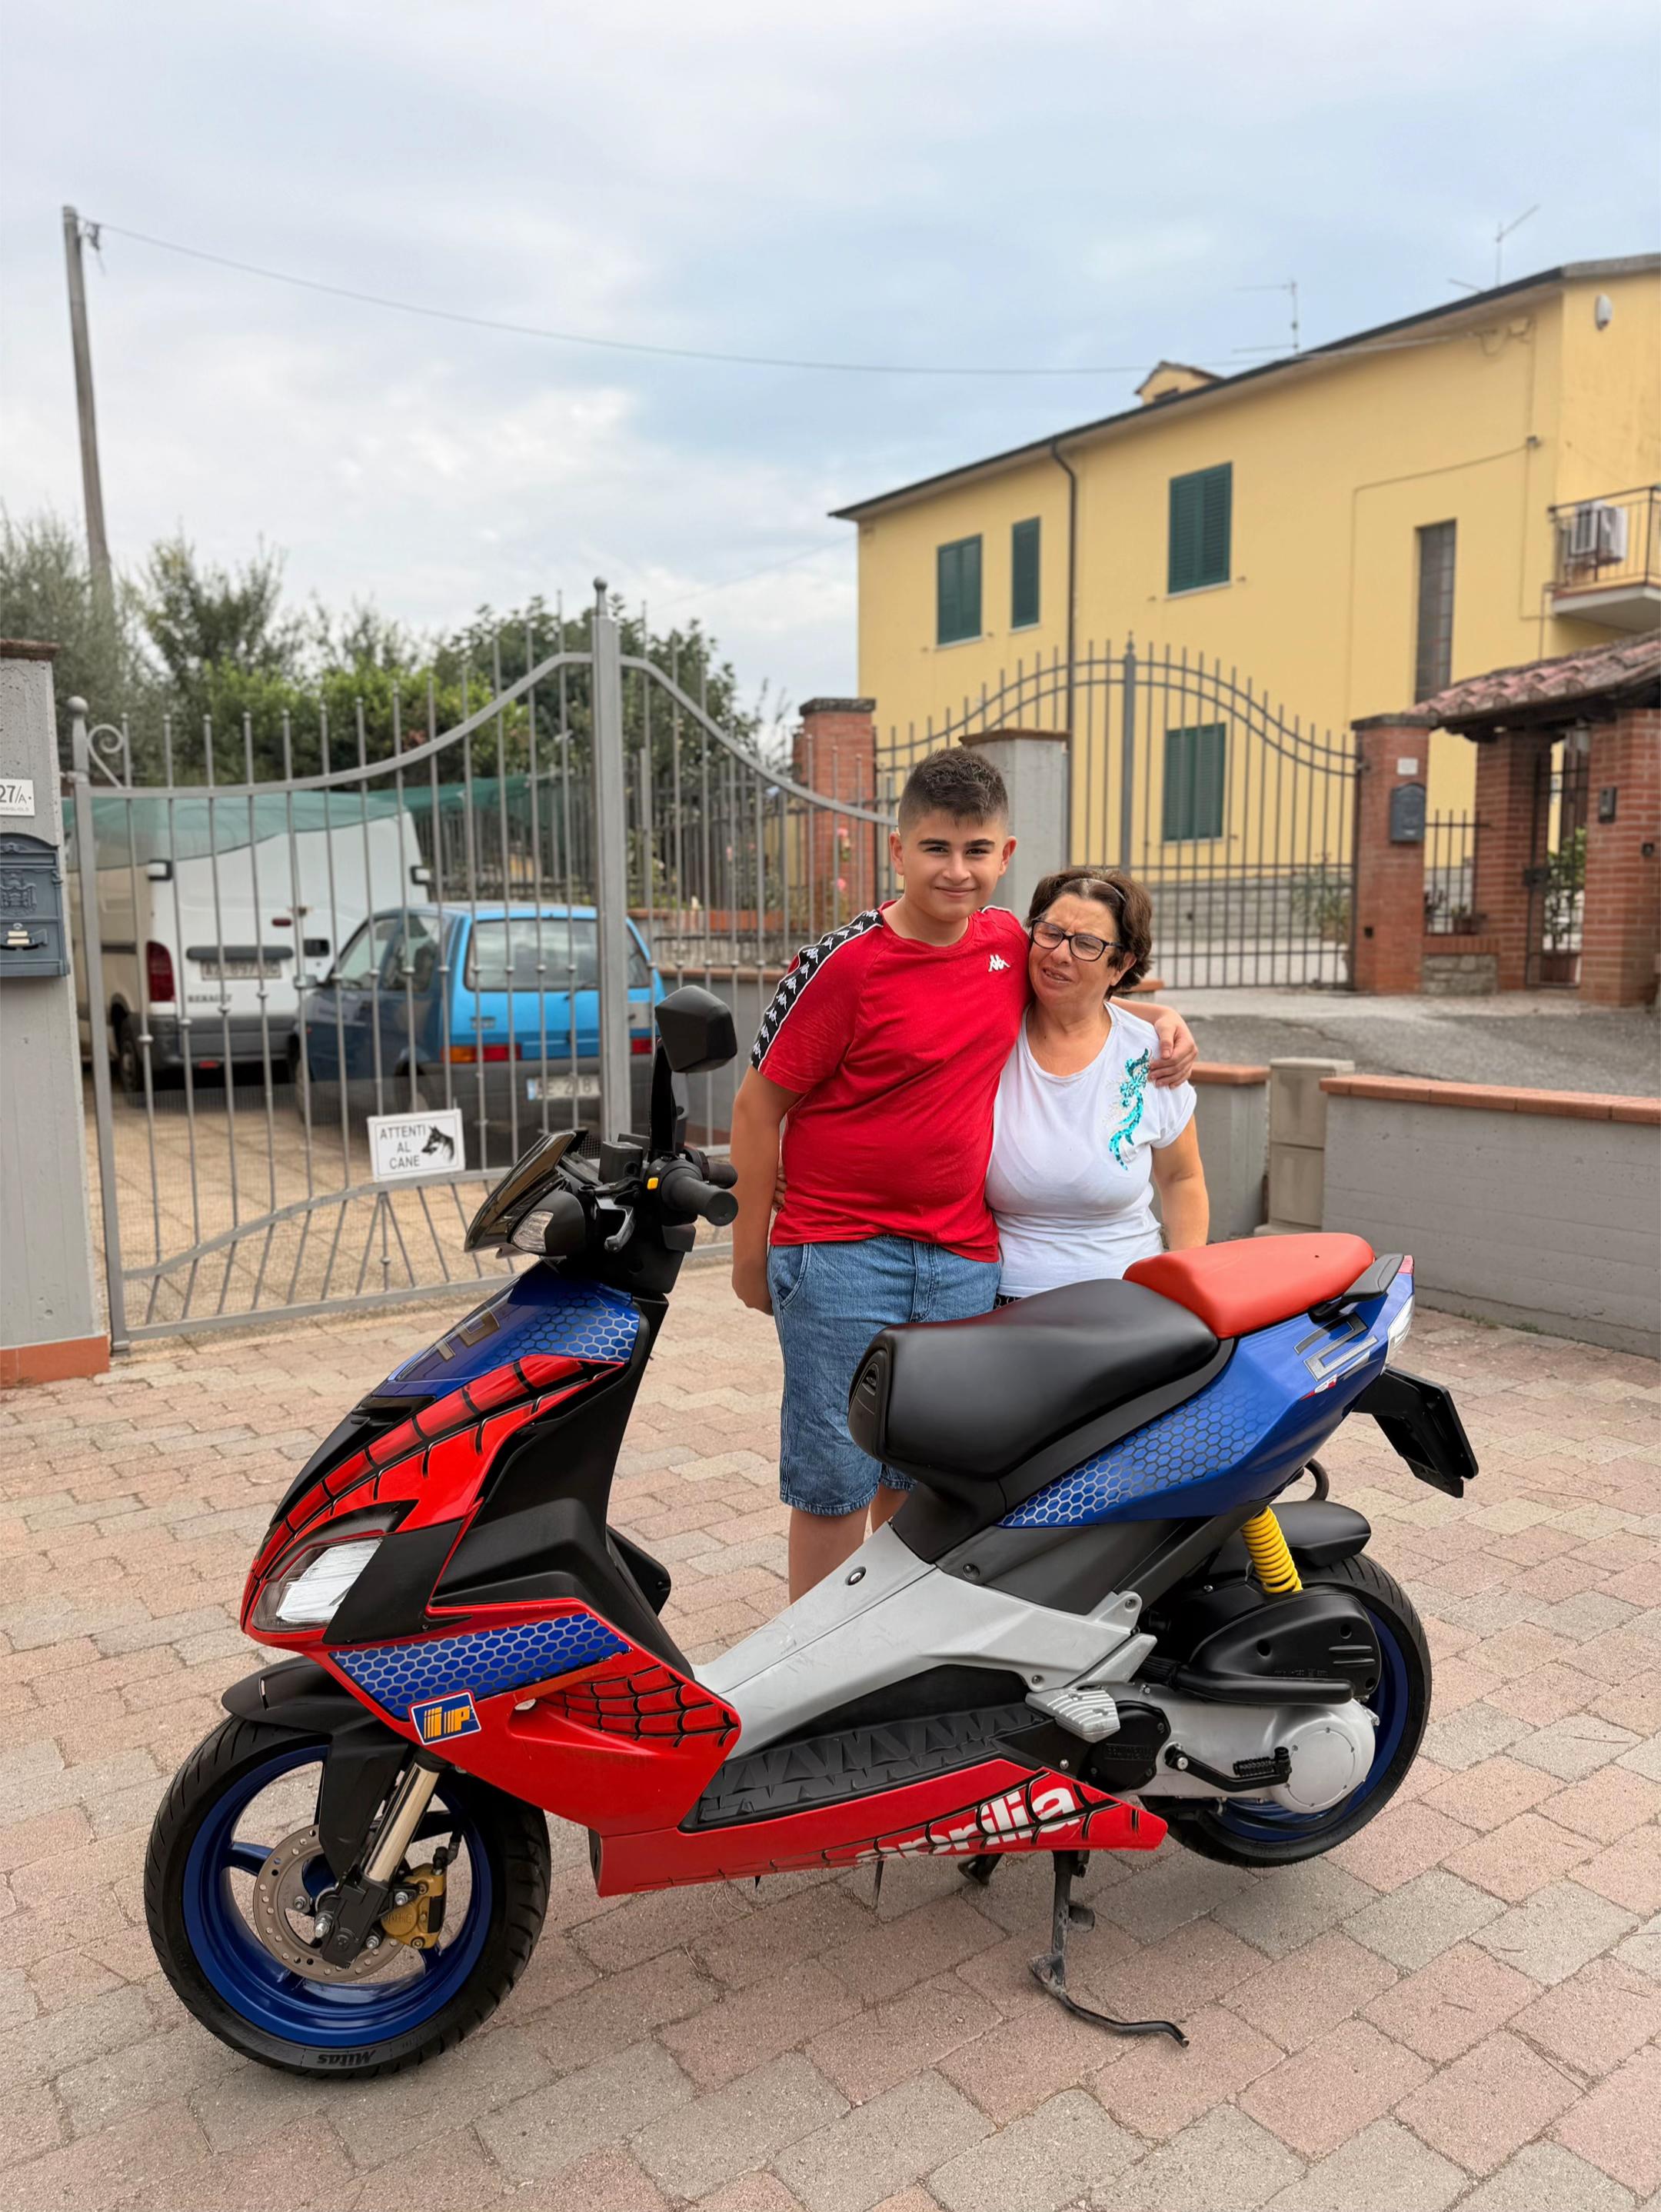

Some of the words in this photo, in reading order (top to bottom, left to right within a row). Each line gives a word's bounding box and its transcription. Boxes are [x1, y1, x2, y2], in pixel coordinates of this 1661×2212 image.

[380, 1124, 425, 1139] ATTENTI
[397, 1142, 411, 1153] AL
[389, 1155, 420, 1169] CANE
[318, 2050, 376, 2067] Mitas
